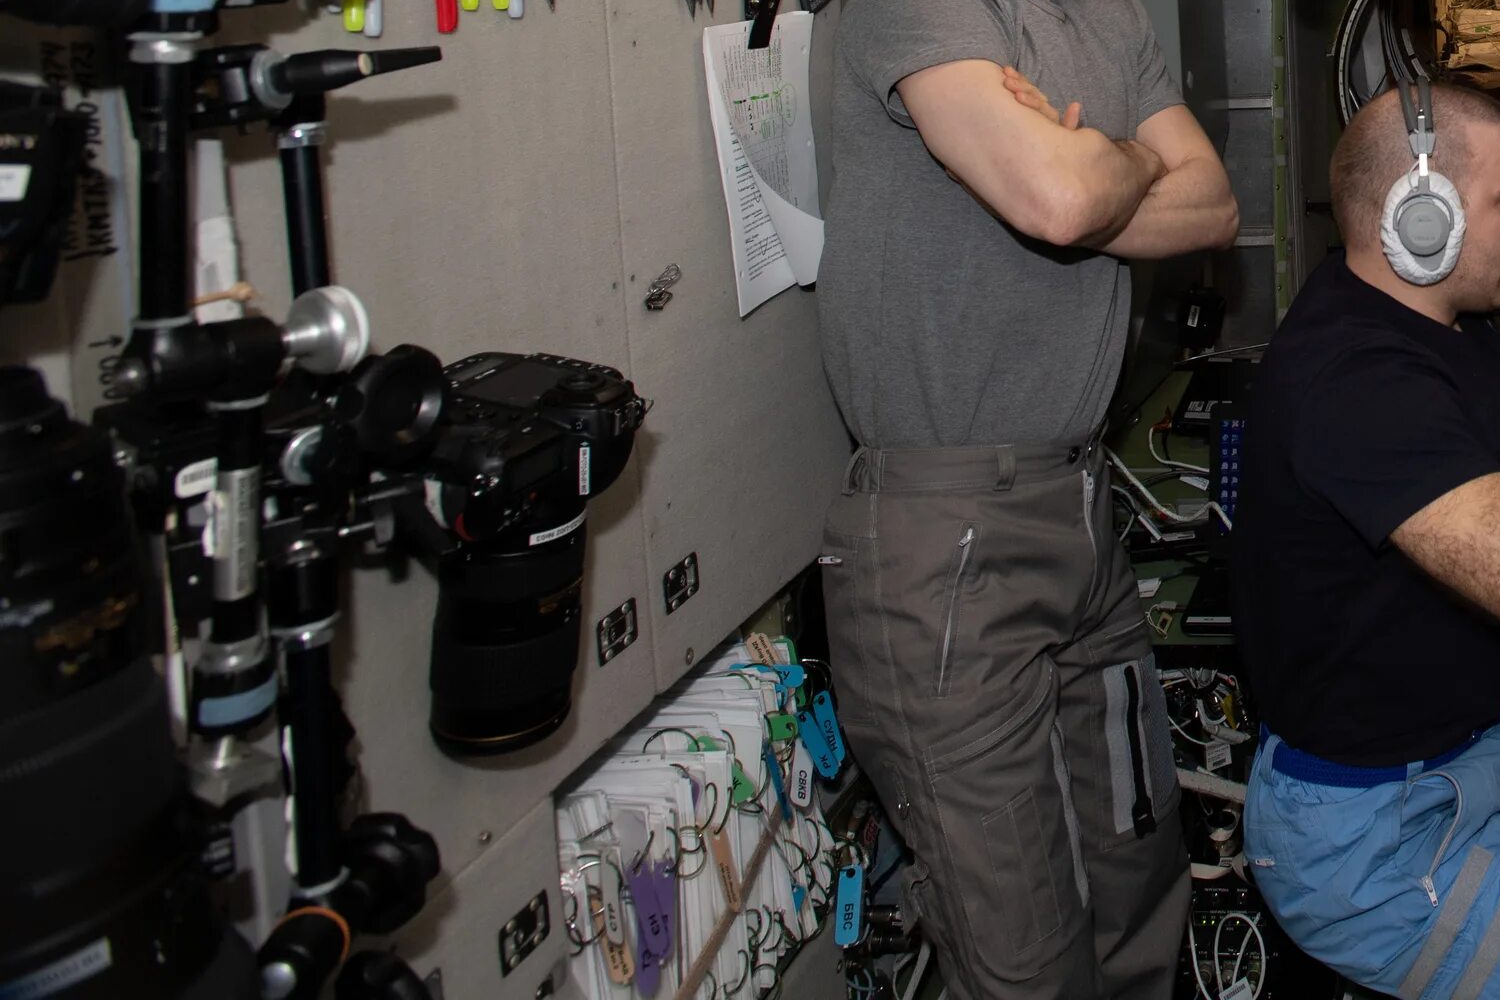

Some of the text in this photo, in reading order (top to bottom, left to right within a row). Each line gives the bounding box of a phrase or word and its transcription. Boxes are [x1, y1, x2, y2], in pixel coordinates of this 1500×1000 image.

[823, 719, 839, 751] СУДН
[818, 754, 831, 769] РК
[798, 769, 808, 800] СВКВ
[842, 903, 854, 931] БВС
